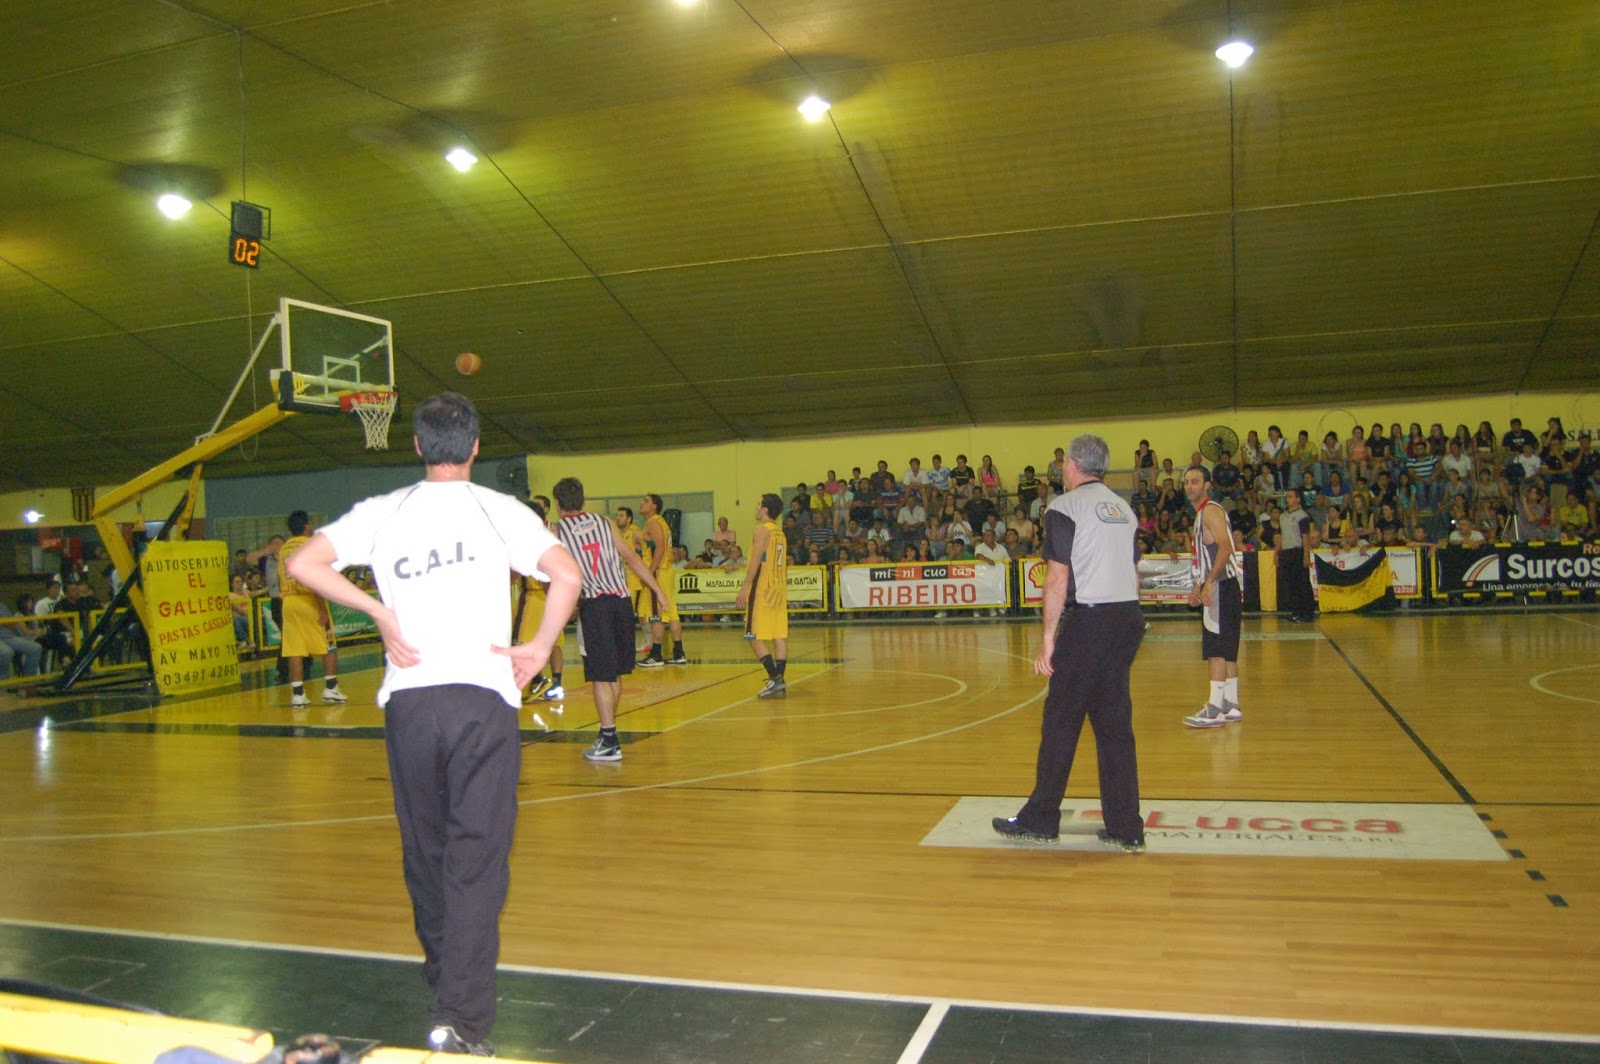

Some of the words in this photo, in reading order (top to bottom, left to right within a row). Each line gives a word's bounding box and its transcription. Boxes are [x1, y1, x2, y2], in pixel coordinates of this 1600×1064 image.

[234, 238, 260, 266] 02
[582, 541, 600, 577] 7
[1507, 553, 1600, 580] Surcos
[188, 572, 206, 588] EL
[1483, 582, 1503, 592] Una
[869, 583, 977, 606] RIBEIRO
[158, 595, 231, 618] GALLEGO
[159, 625, 201, 645] PASTAS
[189, 646, 220, 662] MAYO
[163, 669, 206, 686] 03491
[1144, 811, 1403, 833] Lucca
